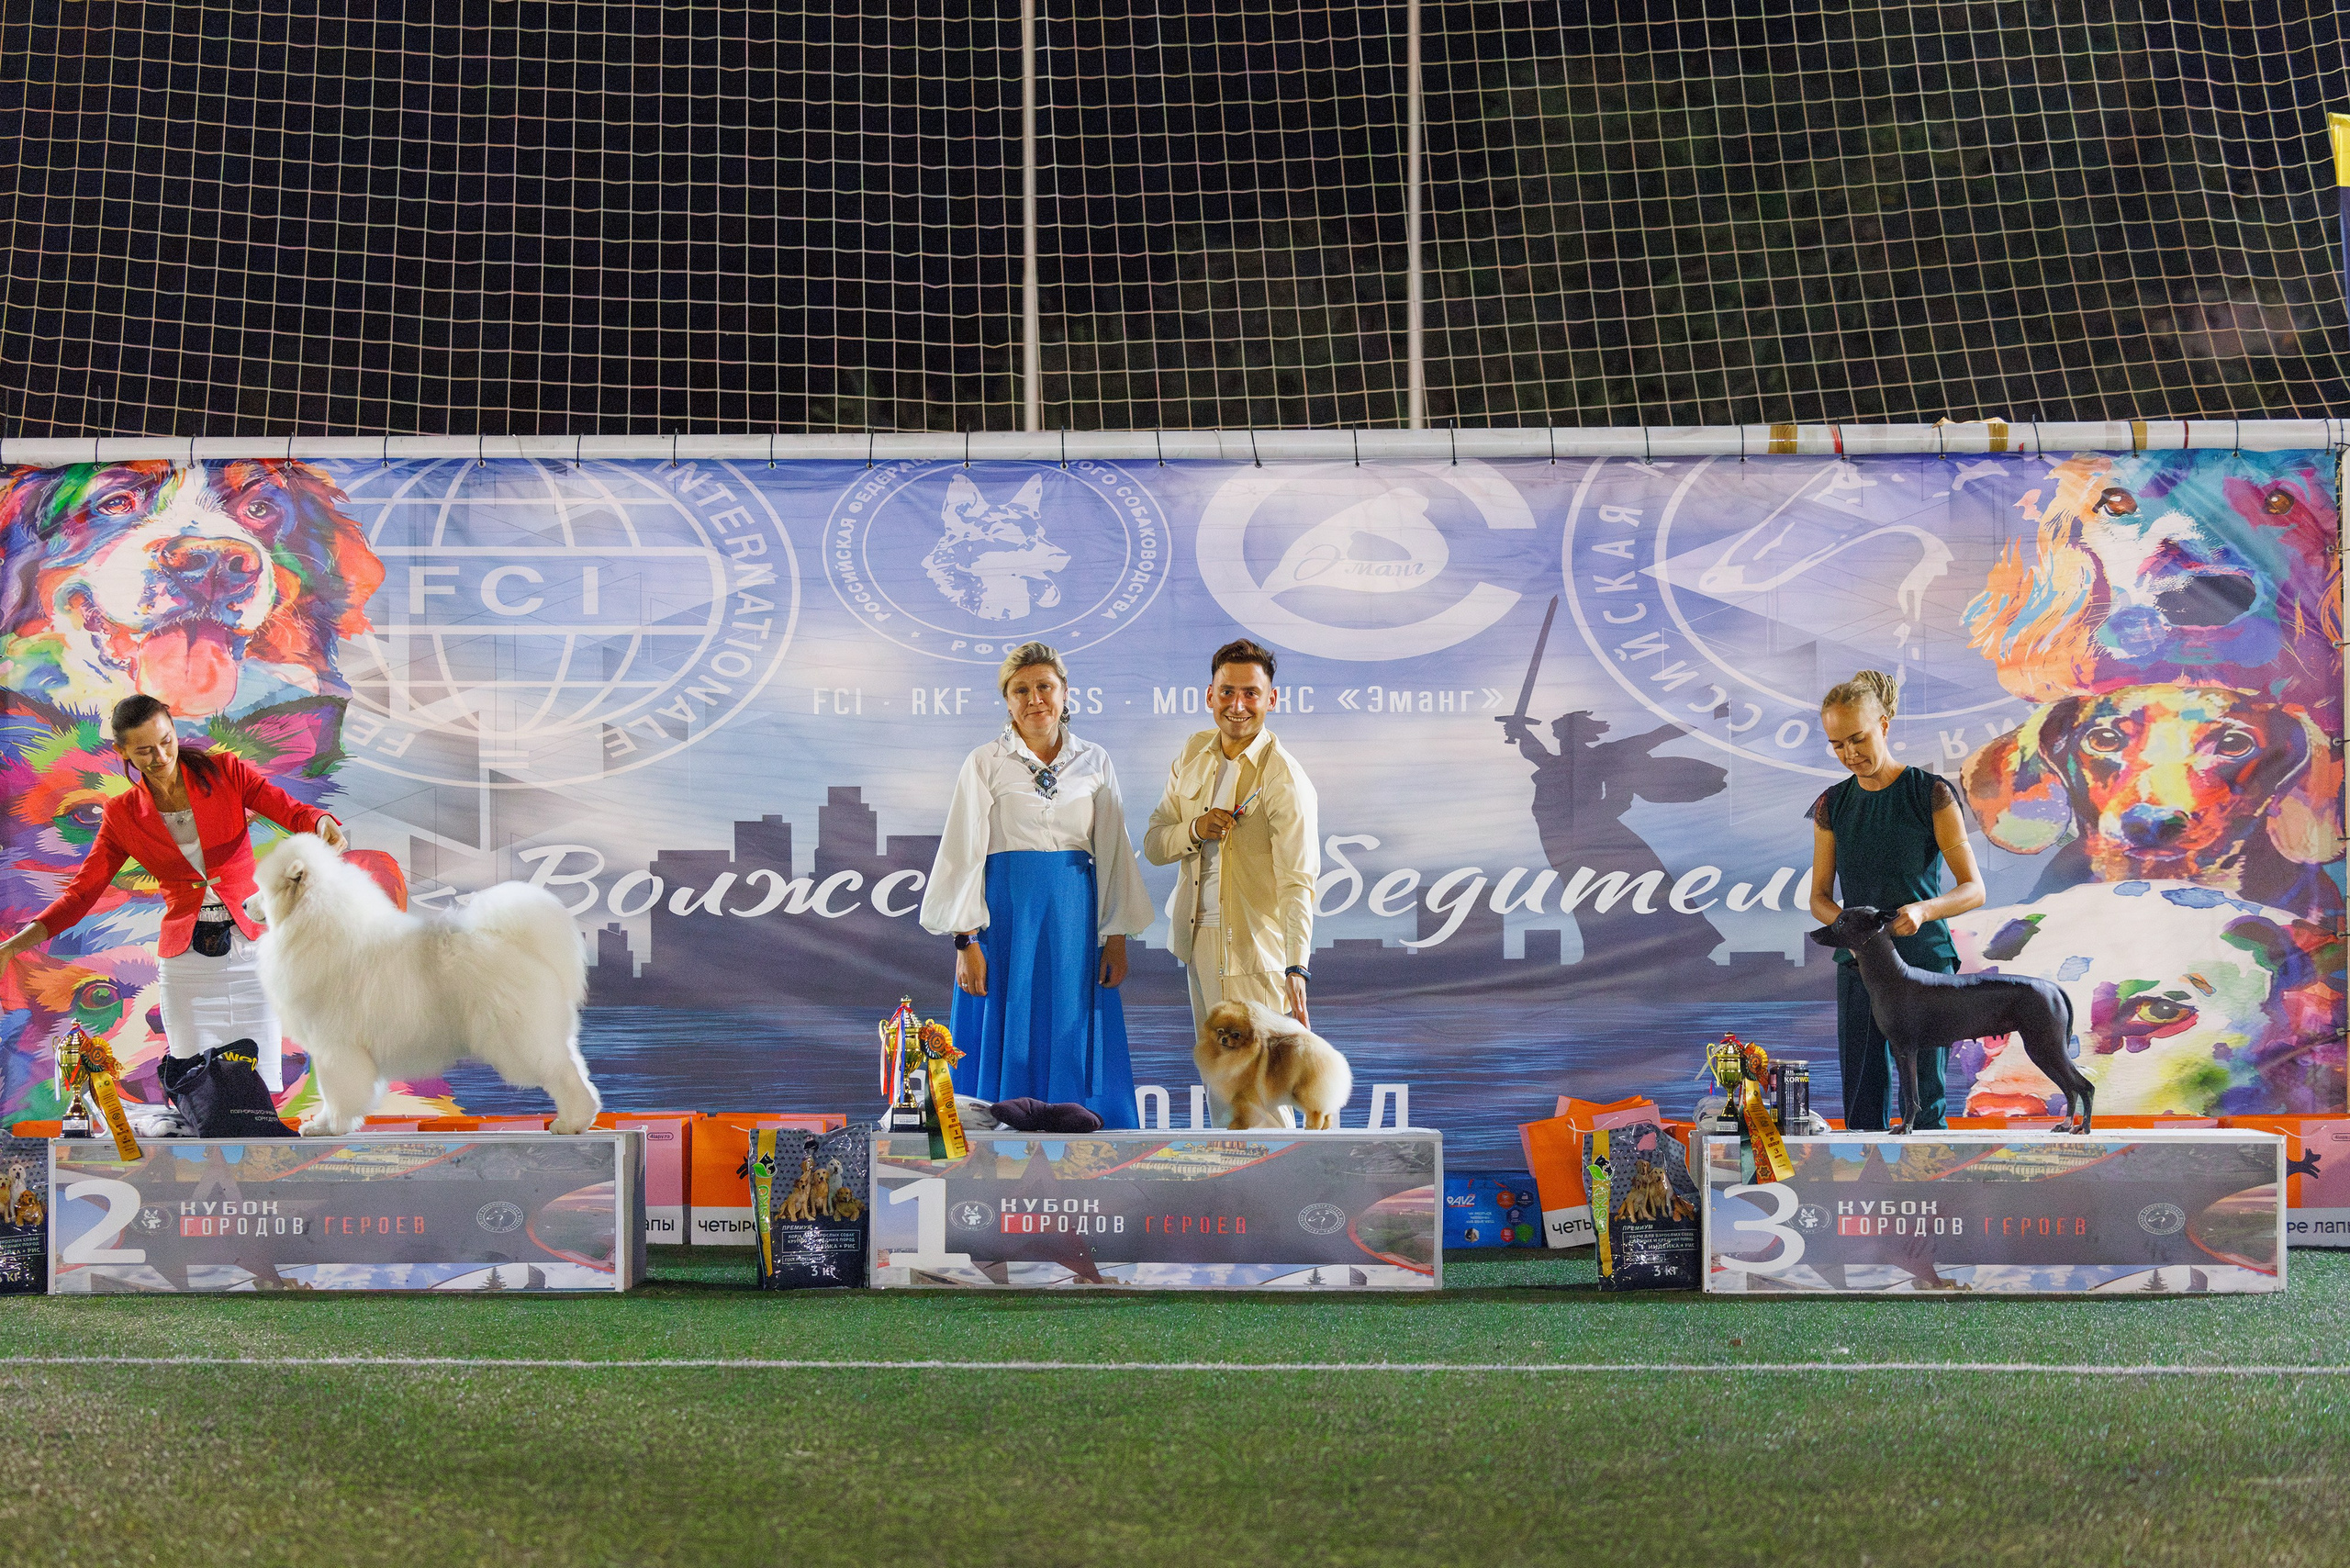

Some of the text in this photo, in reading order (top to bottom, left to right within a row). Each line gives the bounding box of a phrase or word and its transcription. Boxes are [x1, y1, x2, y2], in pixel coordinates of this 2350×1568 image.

[834, 458, 934, 622] РОССИЙСКАЯ ФЕДЕРА
[1102, 486, 1157, 620] СОБАКОВОДСТВА
[408, 565, 599, 616] FCI
[595, 460, 778, 759] INTERNATIONALE
[1591, 503, 1839, 758] ОССИЙСКАЯ
[813, 687, 863, 716] FCI
[912, 687, 972, 716] RKF
[1065, 687, 1103, 716] SS
[1337, 685, 1505, 716] «Эманг»
[1310, 834, 1843, 948] бедител
[180, 1201, 279, 1215] КУБОК
[1001, 1198, 1100, 1213] КУБОК
[1838, 1200, 1937, 1215] КУБОК
[63, 1179, 147, 1264] 2
[184, 1217, 304, 1236] ГОРОДОВ
[324, 1216, 425, 1235] ГЕРОЕВ
[889, 1178, 971, 1269] 1
[1003, 1215, 1125, 1234] ГОРОДОВ
[1146, 1215, 1247, 1234] ГЕРОЕВ
[1719, 1182, 1806, 1274] 3
[1841, 1216, 1963, 1237] ГОРОДОВ
[1984, 1216, 2087, 1236] ГЕРОЕВ
[2312, 1221, 2350, 1234] лап
[811, 1265, 819, 1277] 3
[1653, 1265, 1662, 1277] 3
